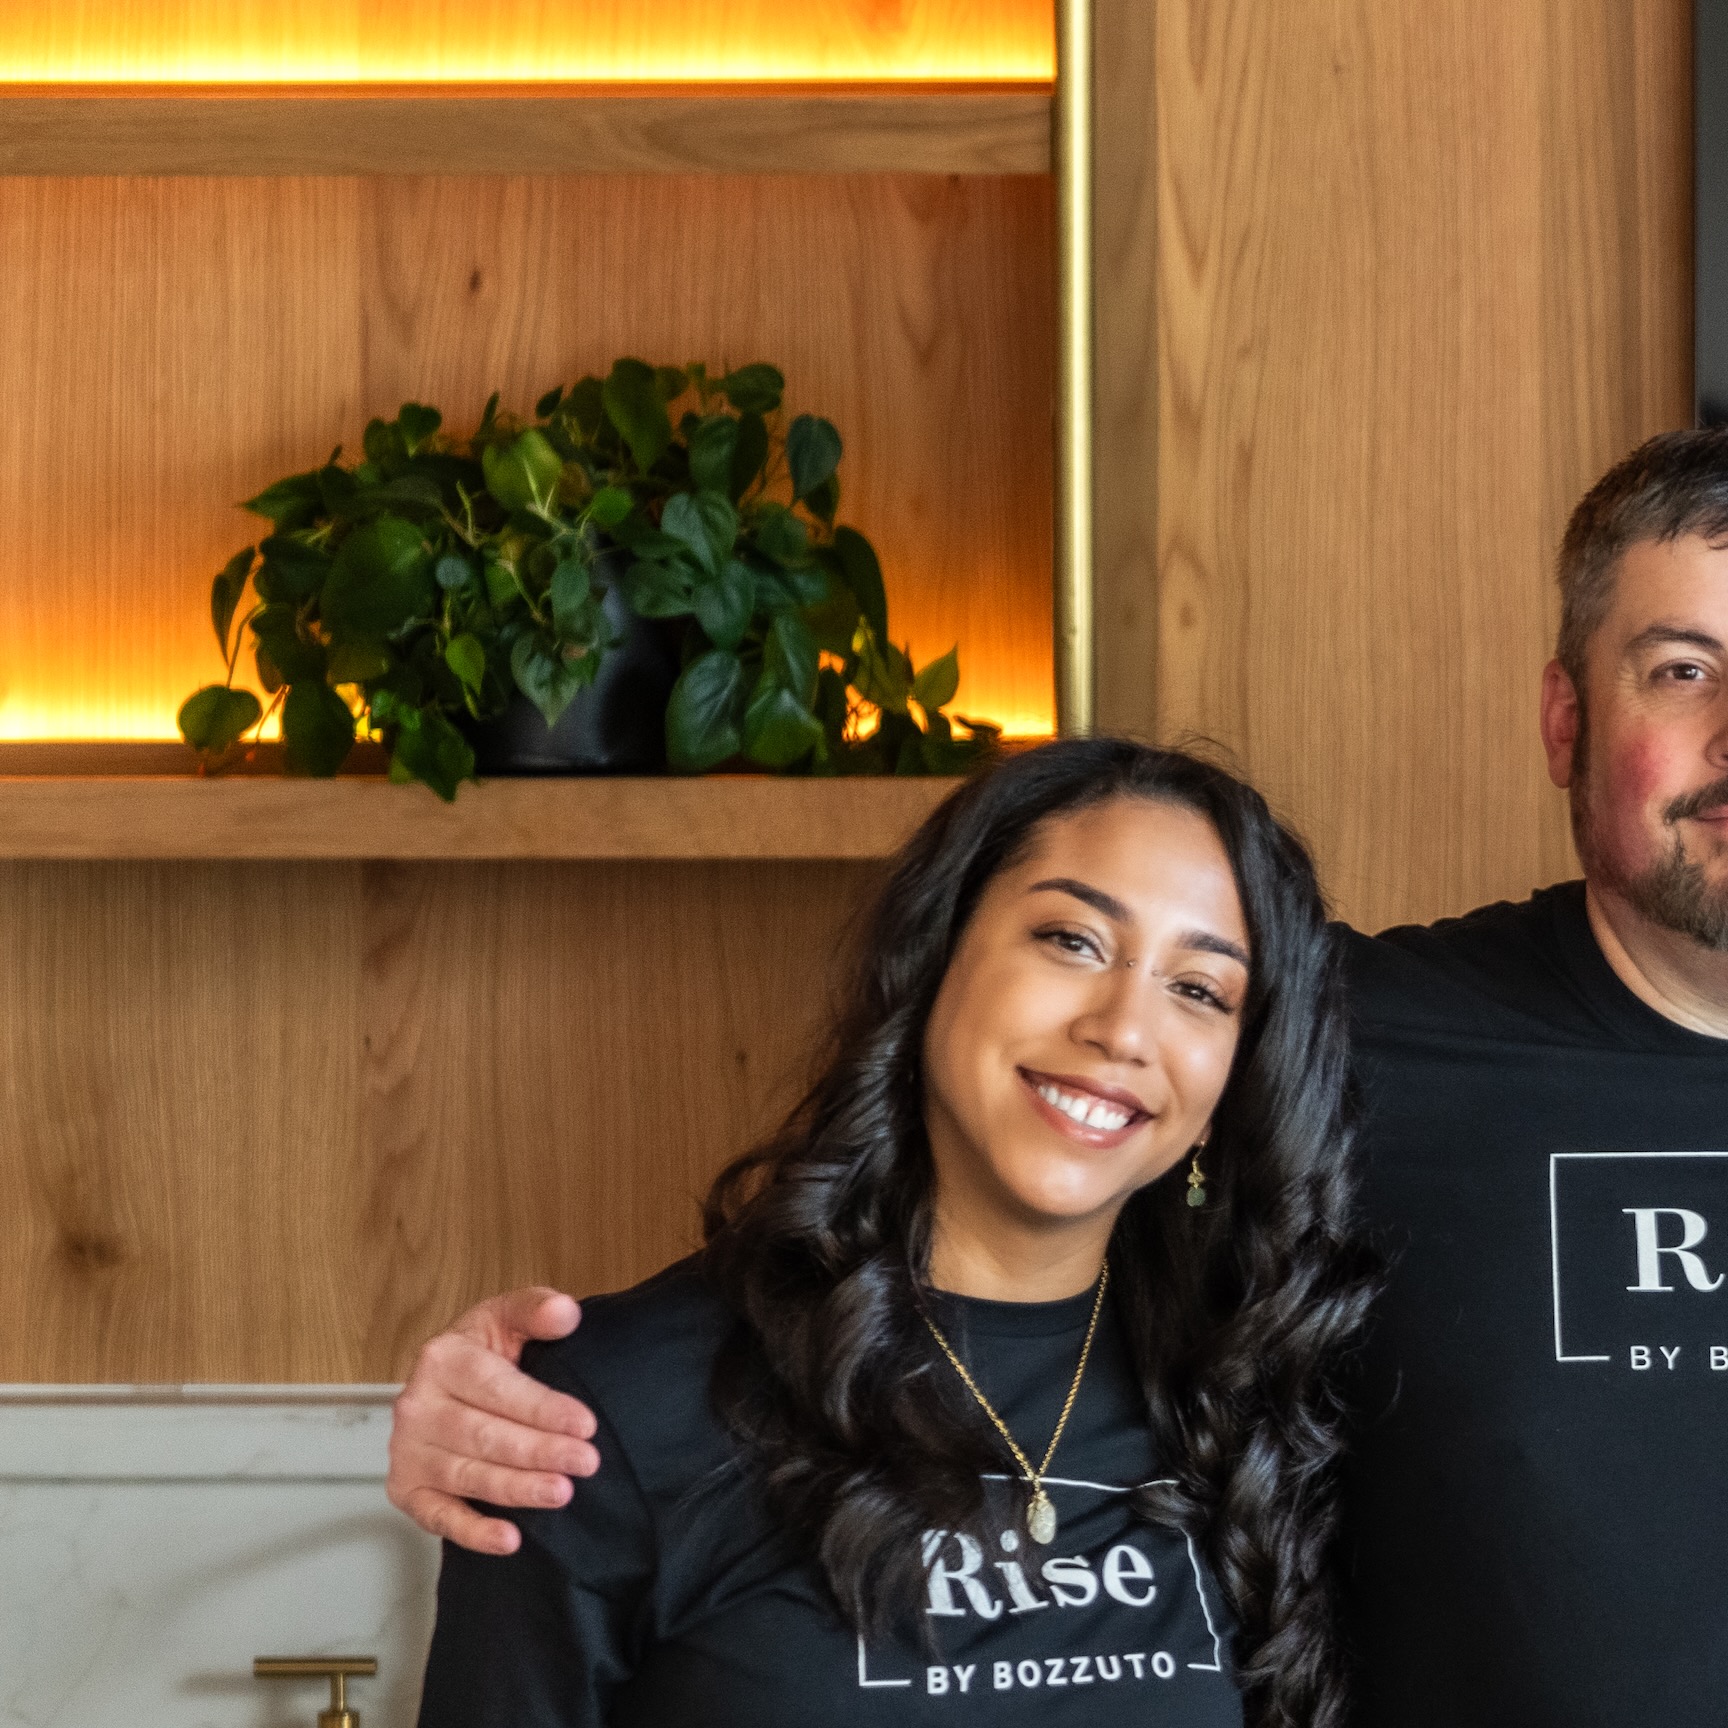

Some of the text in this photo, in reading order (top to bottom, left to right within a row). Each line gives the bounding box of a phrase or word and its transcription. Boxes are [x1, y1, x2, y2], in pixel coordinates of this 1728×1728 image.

[1630, 1345, 1681, 1370] BY
[921, 1529, 1157, 1619] Rise
[927, 1651, 1176, 1694] BY BOZZUTO
